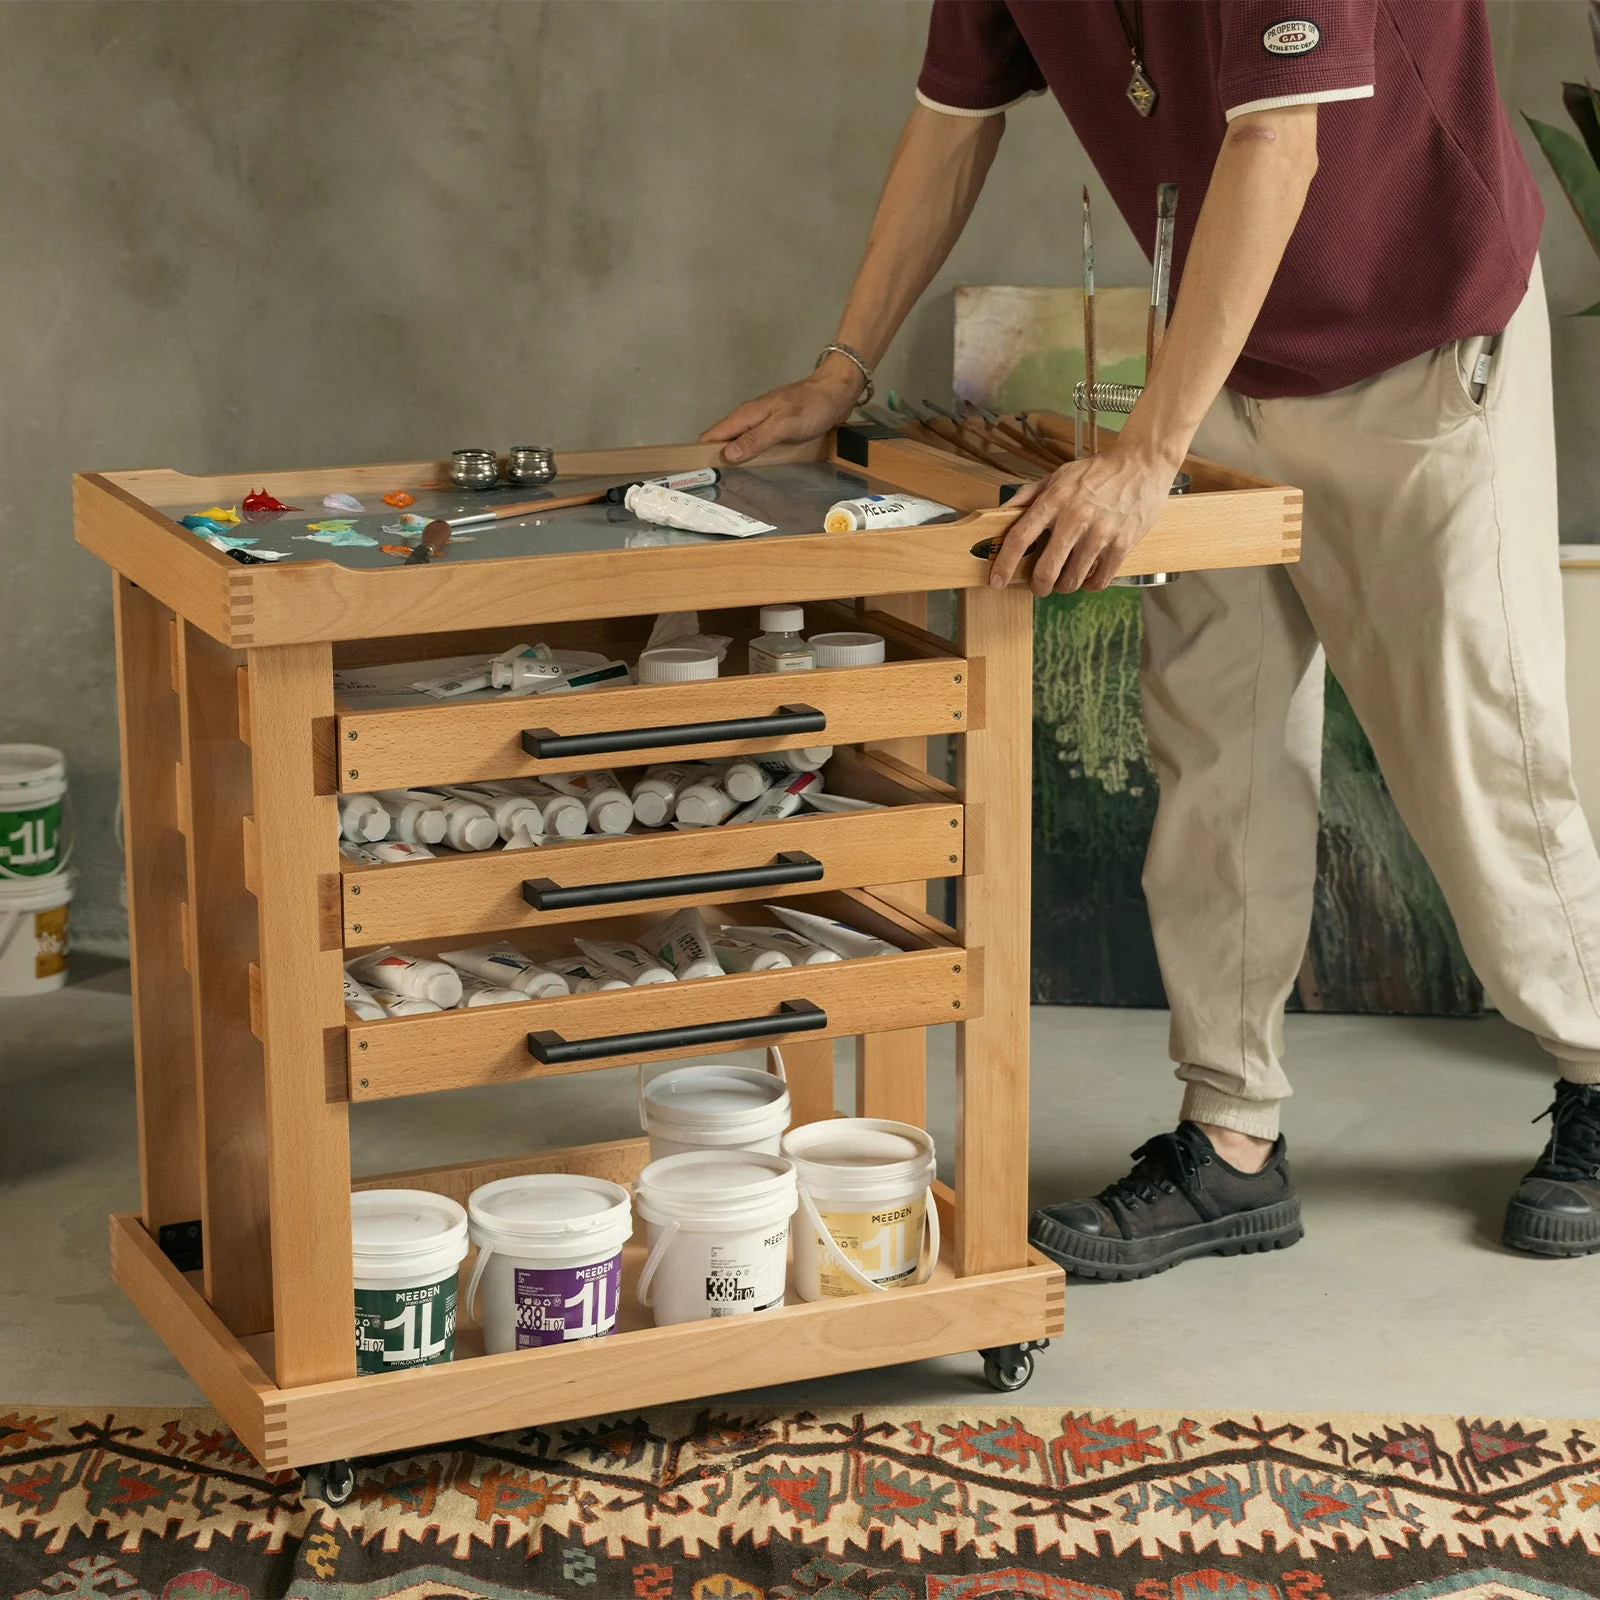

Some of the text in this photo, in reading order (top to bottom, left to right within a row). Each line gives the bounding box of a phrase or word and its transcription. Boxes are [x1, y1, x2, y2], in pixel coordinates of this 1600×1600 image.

[1267, 23, 1306, 40] PROPERTY
[1282, 34, 1304, 42] GAP
[1268, 43, 1300, 52] ATHLETIC
[9, 818, 56, 865] 1L
[872, 1206, 912, 1223] MEEDEN
[862, 1222, 918, 1280] 1L
[576, 1260, 613, 1280] MEEDEN
[396, 1285, 440, 1302] MEEDEN
[564, 1278, 616, 1340] 1L
[383, 1302, 446, 1362] 1L
